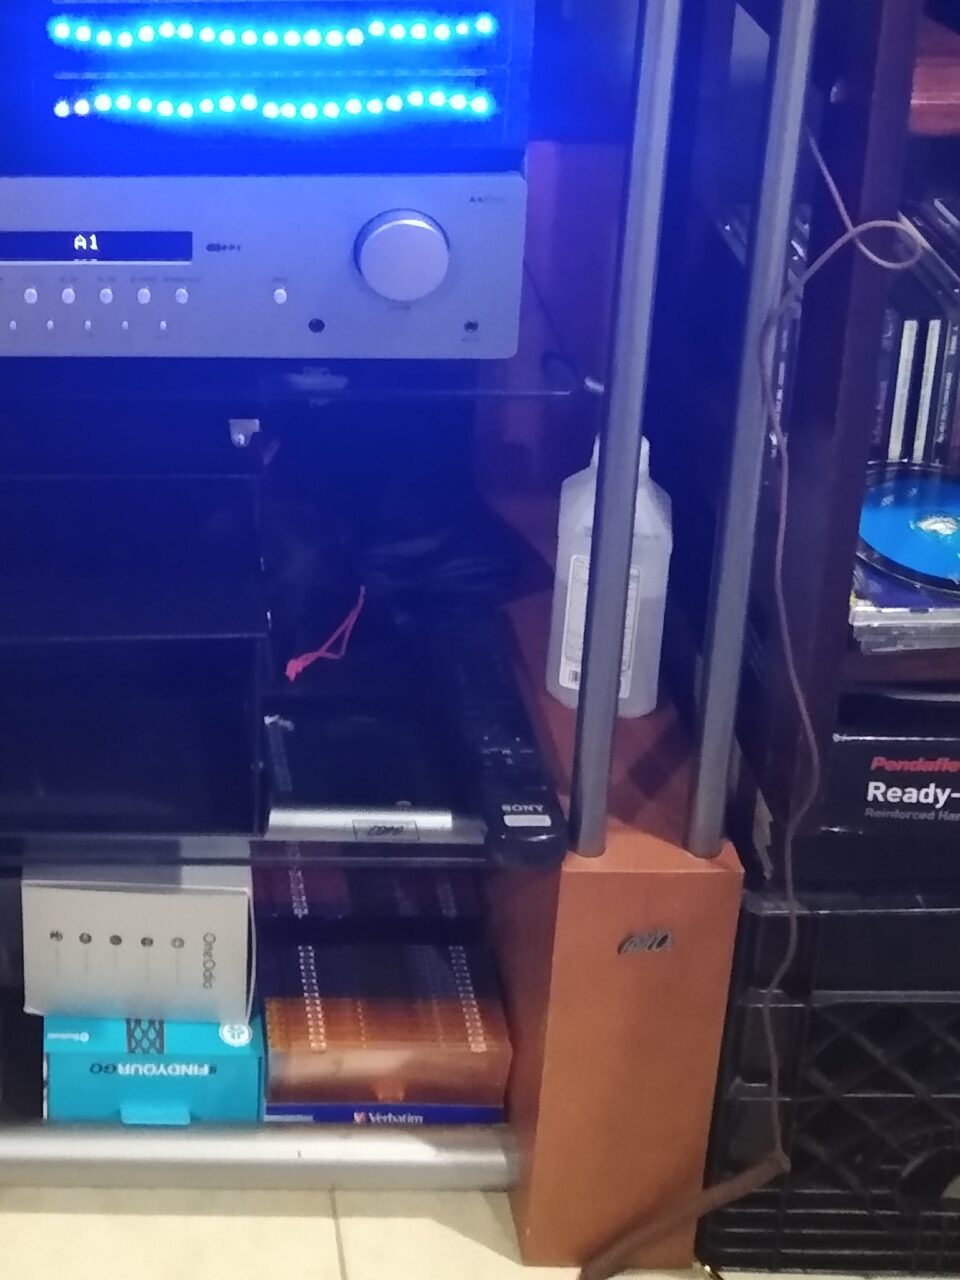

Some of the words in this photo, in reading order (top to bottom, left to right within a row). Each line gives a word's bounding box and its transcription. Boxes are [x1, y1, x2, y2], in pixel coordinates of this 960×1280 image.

[74, 233, 98, 250] A1
[866, 781, 960, 809] Ready-
[501, 803, 544, 812] SONY
[369, 1111, 425, 1124] Verbatim
